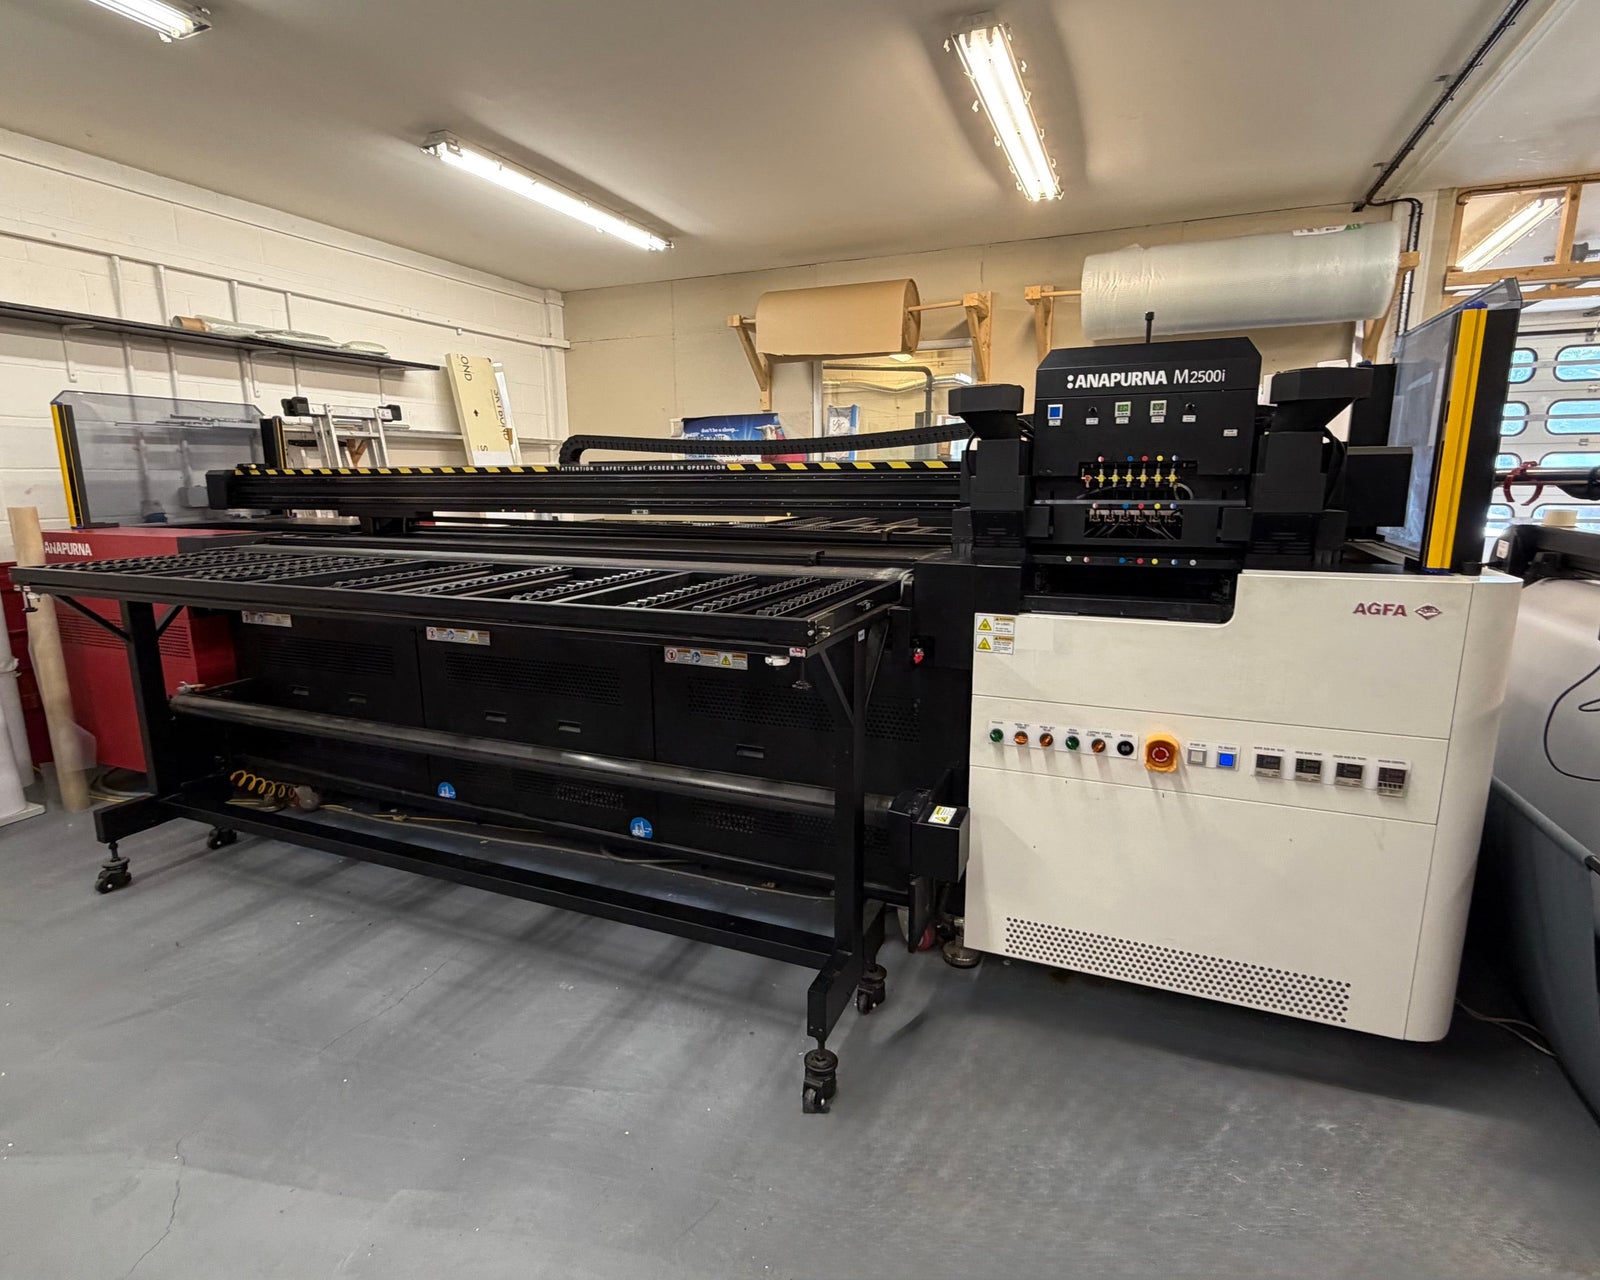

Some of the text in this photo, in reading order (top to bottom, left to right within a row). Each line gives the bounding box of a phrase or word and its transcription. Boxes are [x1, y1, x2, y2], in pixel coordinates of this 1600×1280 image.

[1173, 368, 1226, 385] M2500i
[44, 541, 93, 556] ANAPURNA
[1352, 602, 1407, 617] AGFA
